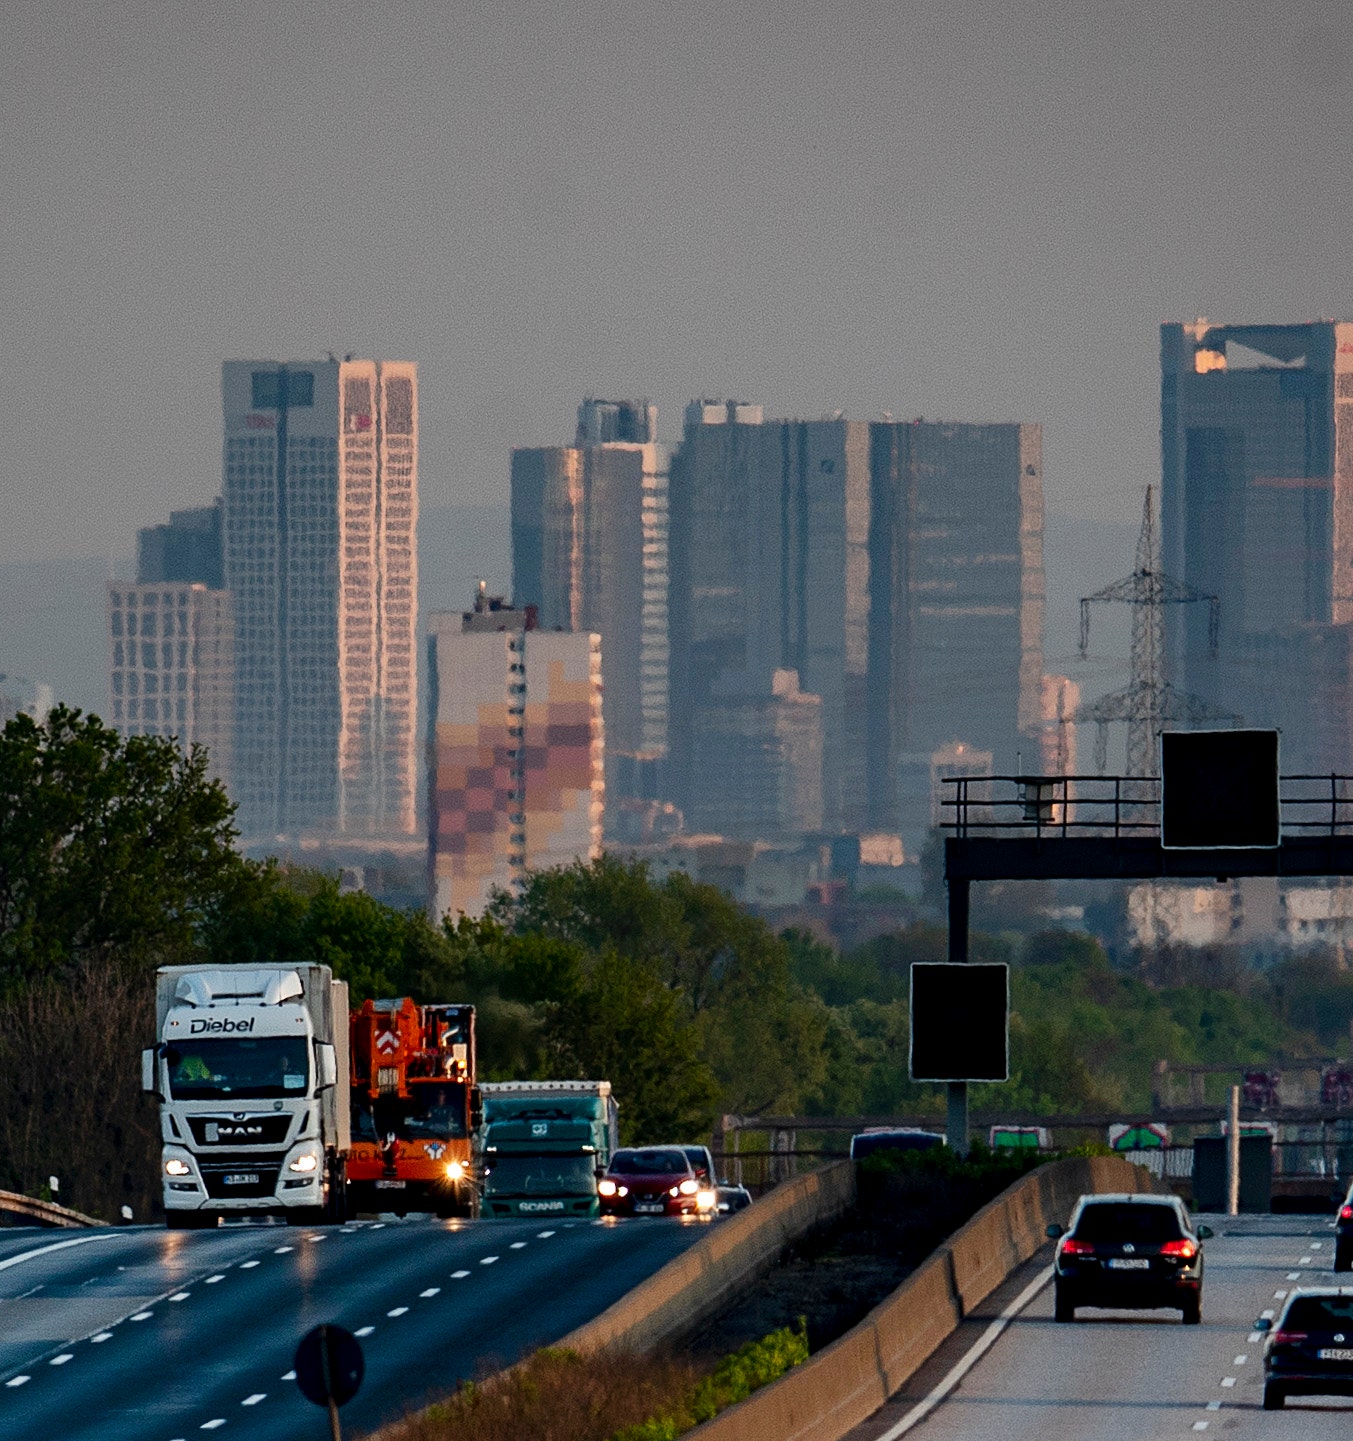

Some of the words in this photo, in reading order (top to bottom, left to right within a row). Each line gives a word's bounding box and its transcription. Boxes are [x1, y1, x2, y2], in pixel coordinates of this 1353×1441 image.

[190, 1017, 255, 1034] Diebel
[217, 1125, 263, 1136] MAN
[518, 1201, 565, 1213] SCANIA
